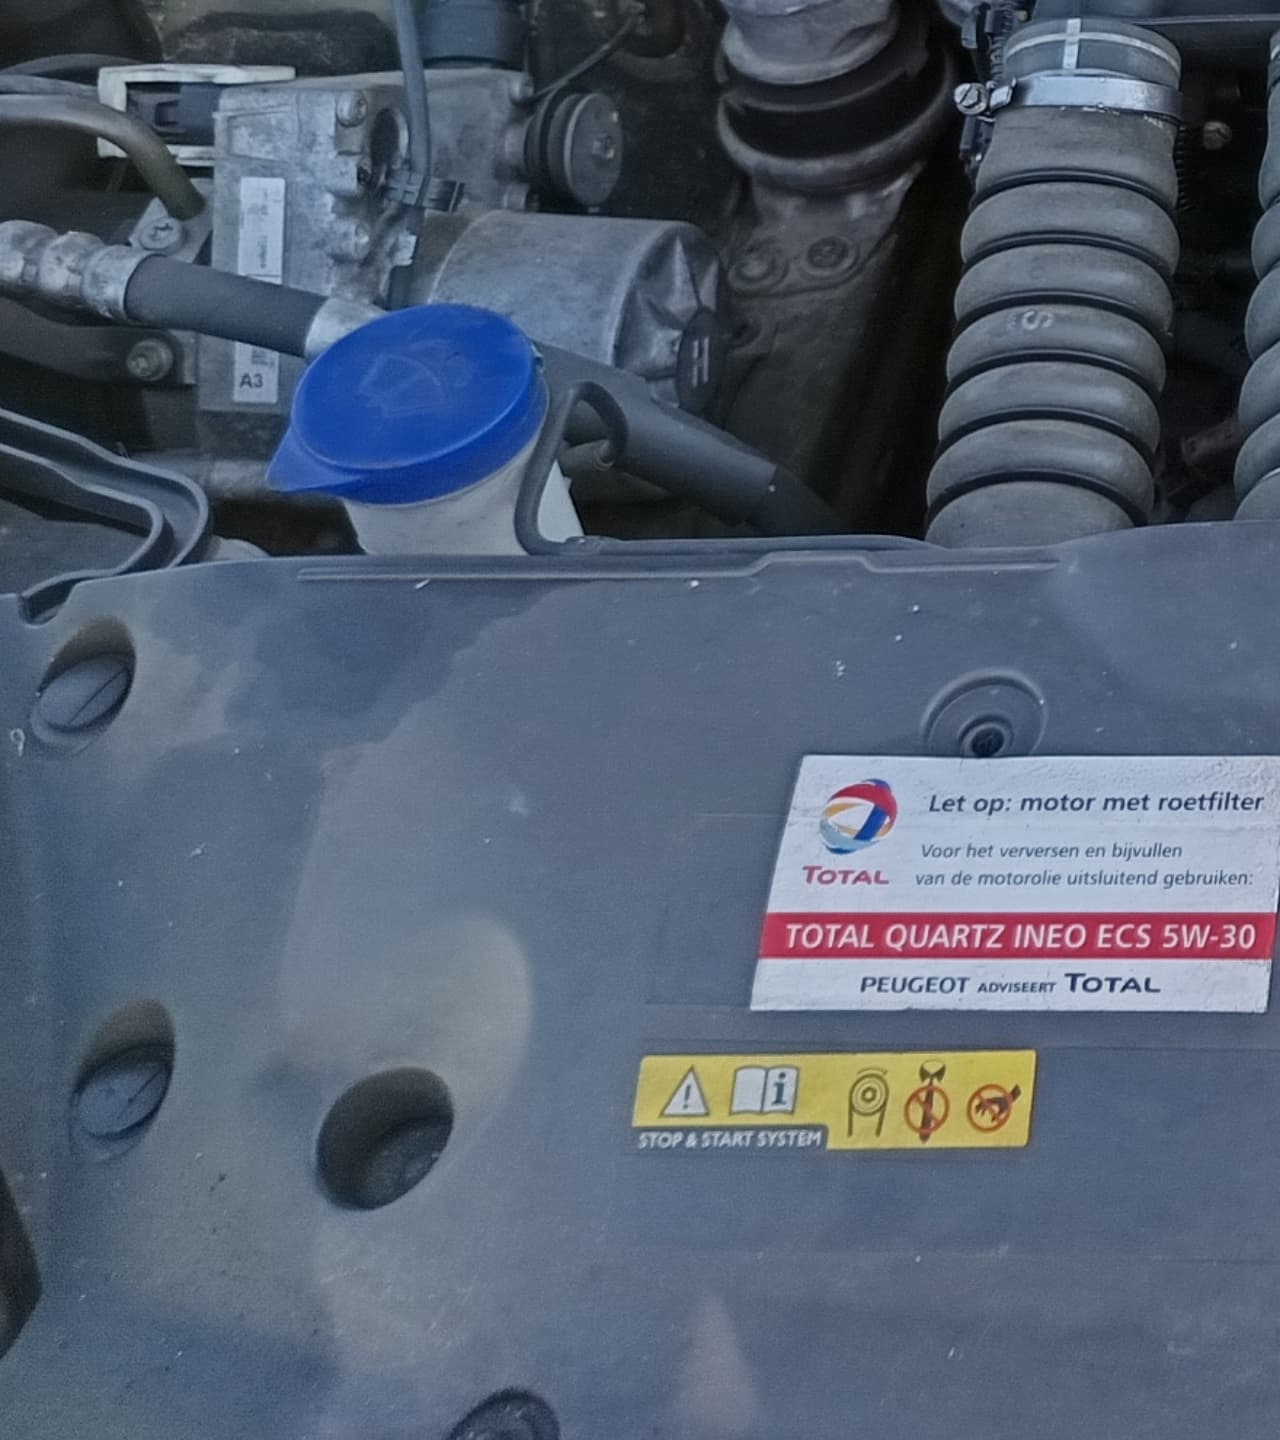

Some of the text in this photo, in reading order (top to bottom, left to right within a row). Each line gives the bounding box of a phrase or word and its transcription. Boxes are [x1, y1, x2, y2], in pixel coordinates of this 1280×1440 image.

[239, 372, 264, 389] A3
[929, 791, 1264, 817] Let op: motor met roetfilter
[921, 842, 1182, 861] Voor het verversen en bijvullen
[802, 865, 889, 886] TOTAL
[915, 869, 1253, 889] van de motorolie uitsluitend gebruiken:
[786, 923, 1256, 952] TOTAL QUARTZ INEO ECS 5W-30
[860, 972, 1161, 993] PEUGEOT ADVISEERT TOTAL
[638, 1129, 823, 1150] STOP & START SYSTEM
